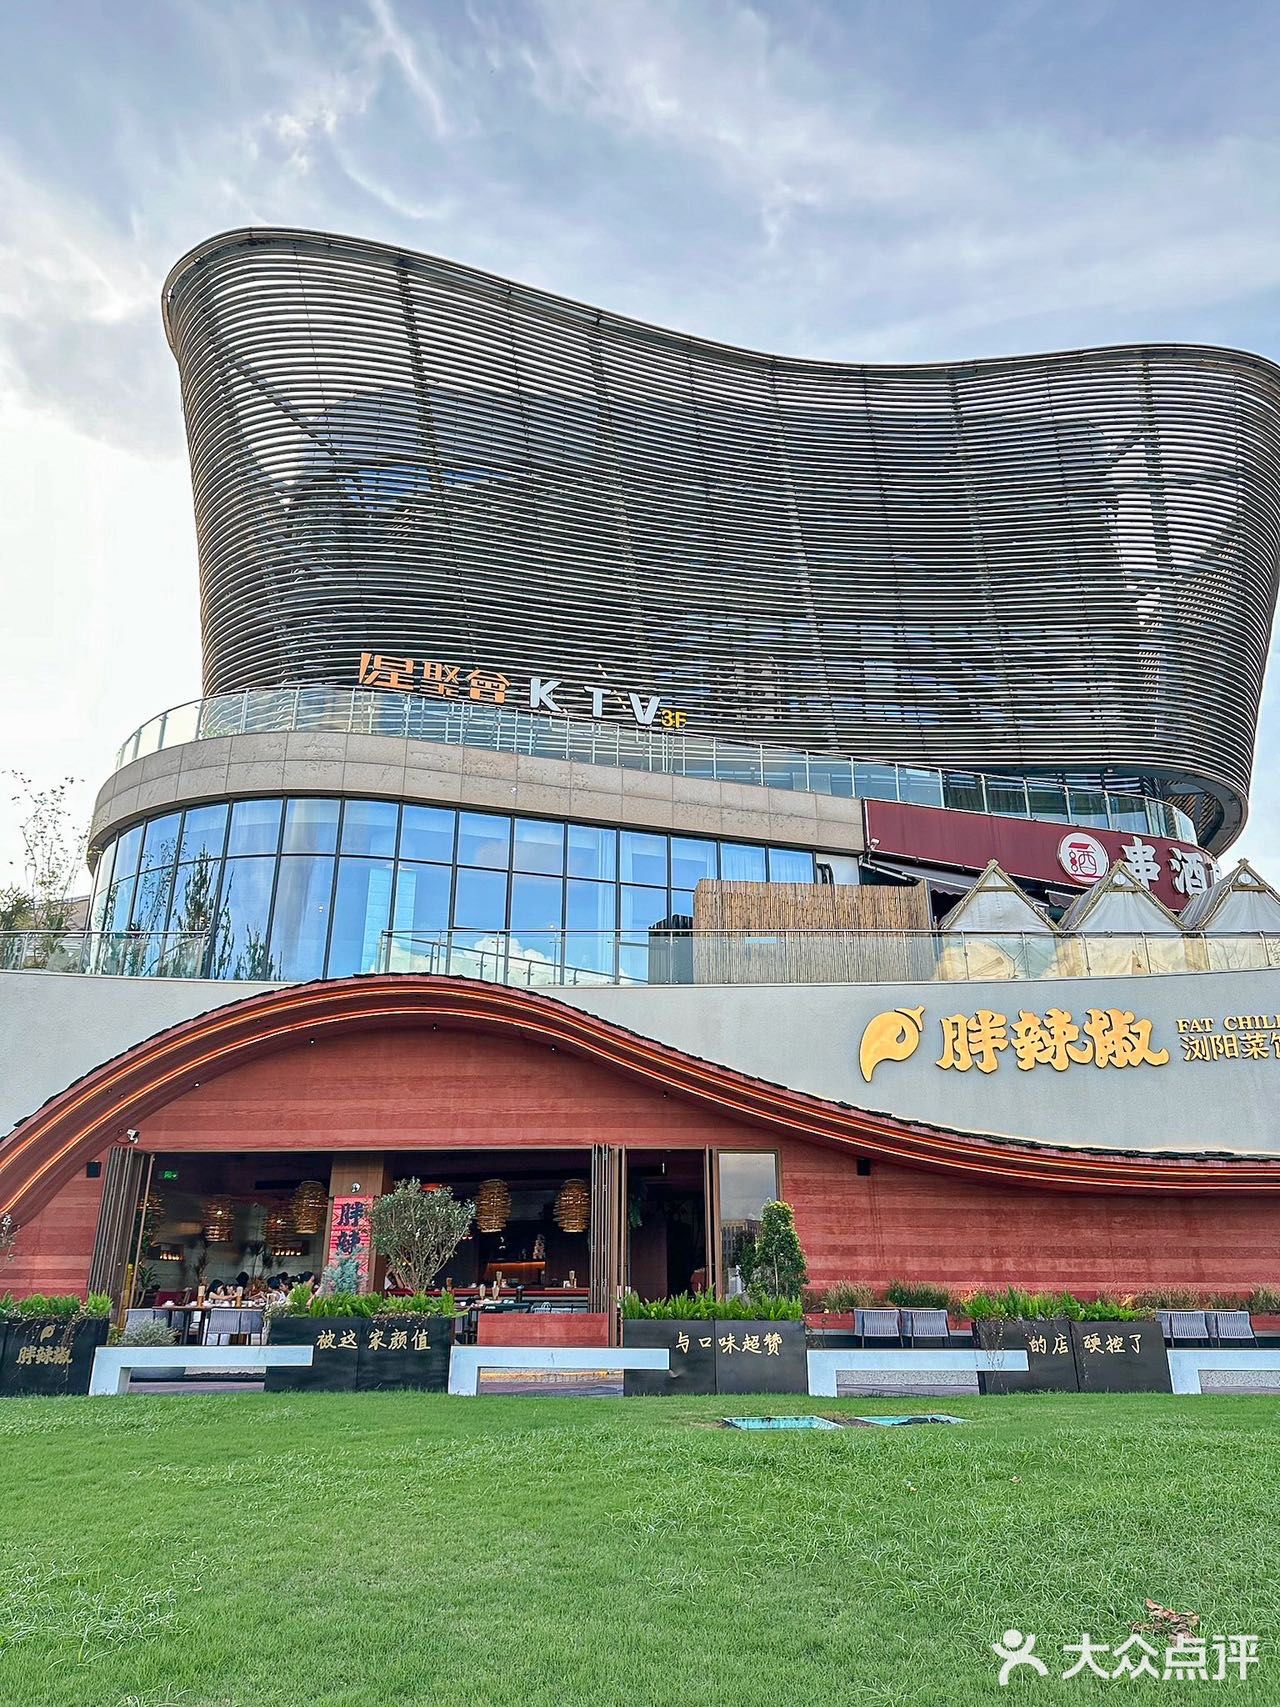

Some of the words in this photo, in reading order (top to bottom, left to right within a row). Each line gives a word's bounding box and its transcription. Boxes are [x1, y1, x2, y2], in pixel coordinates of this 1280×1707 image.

[661, 708, 688, 729] 3F
[1176, 1017, 1214, 1034] FAT
[1223, 1014, 1280, 1031] CHIL
[936, 1006, 1170, 1074] 胖辣椒
[675, 1331, 783, 1356] 与口味超赞
[15, 1345, 73, 1365] 胖辣椒
